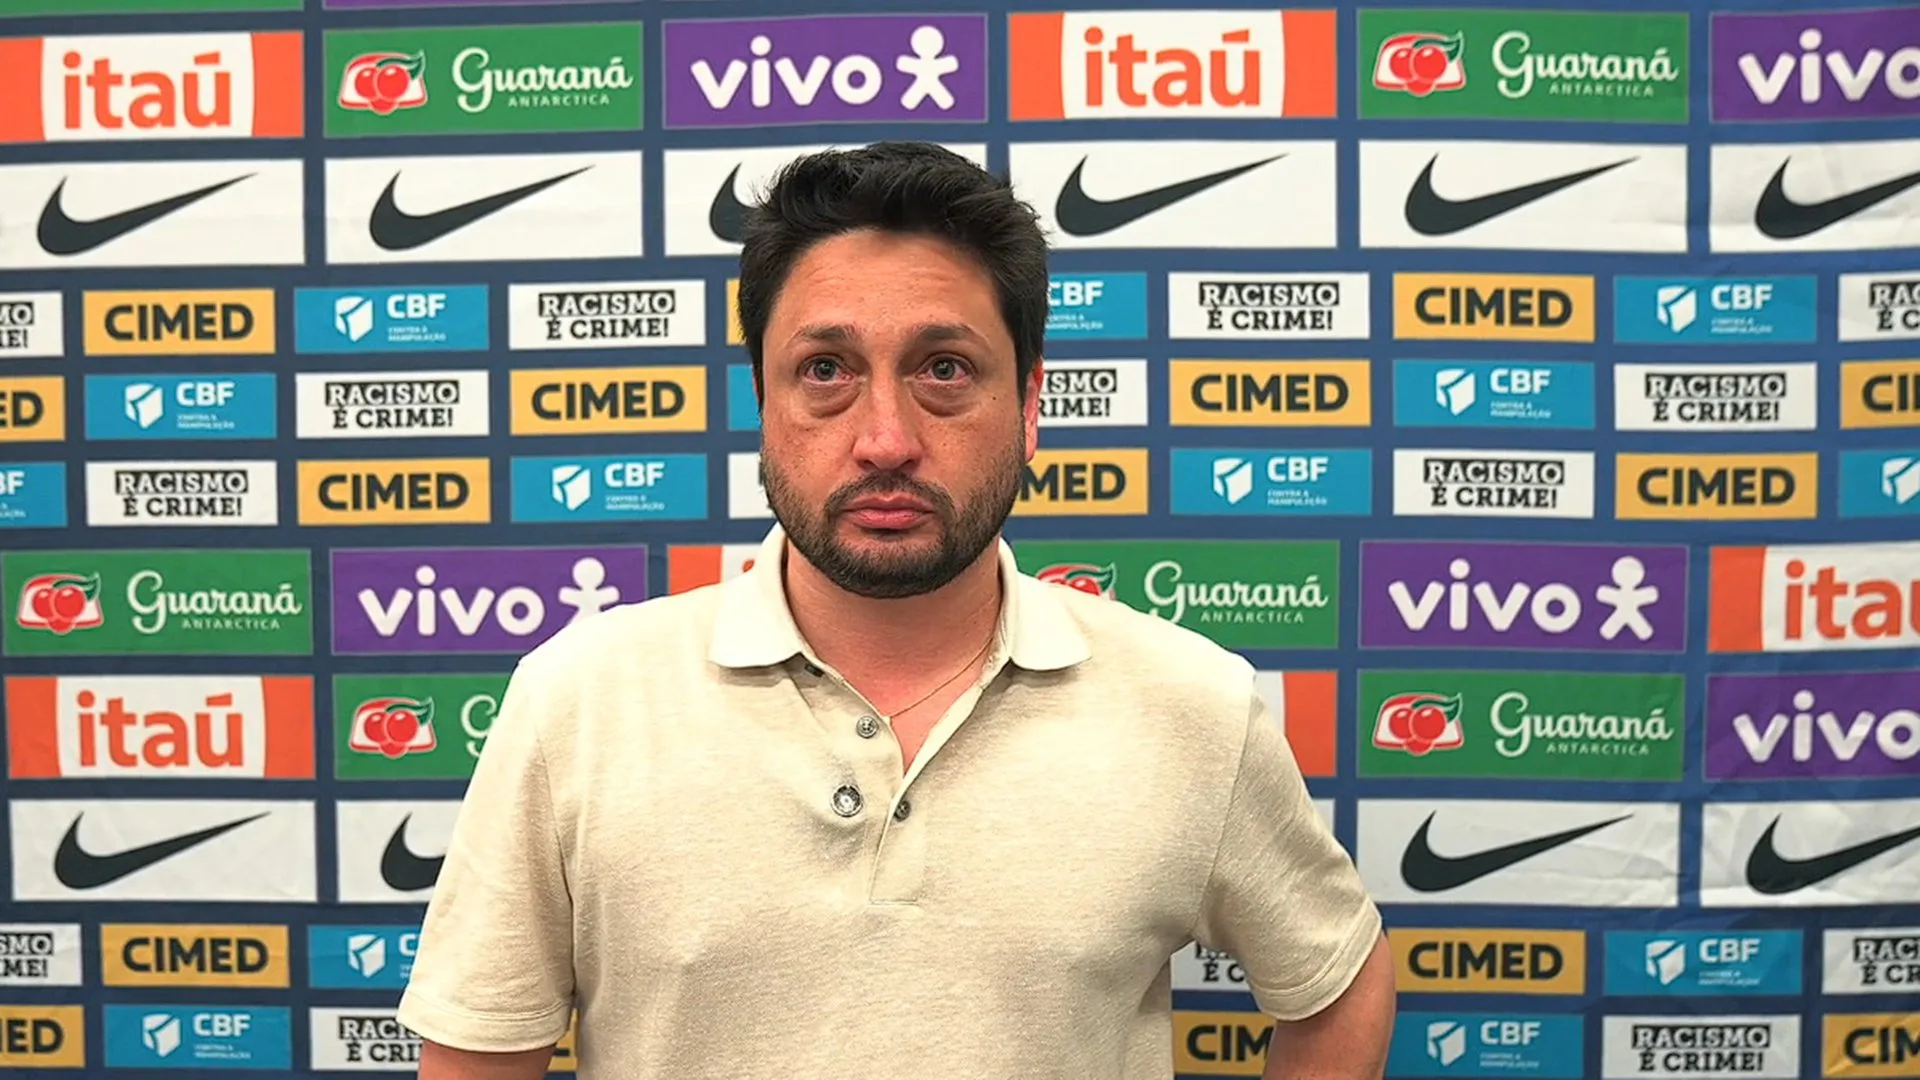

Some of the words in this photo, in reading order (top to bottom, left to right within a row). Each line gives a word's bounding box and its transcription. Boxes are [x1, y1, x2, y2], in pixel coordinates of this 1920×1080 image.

[690, 35, 882, 109] vivo
[1083, 27, 1261, 107] itaú
[1490, 30, 1679, 98] Guaraná
[63, 51, 232, 129] itaú
[451, 47, 632, 112] Guaraná
[1549, 82, 1654, 97] ANTARCTICA
[508, 95, 610, 108] ANTARCTICA
[387, 294, 446, 319] CBF
[541, 291, 673, 315] RACISMO
[1202, 284, 1338, 305] RACISMO
[1415, 287, 1573, 327] CIMED
[1711, 284, 1773, 310] CBF
[104, 303, 254, 341] CIMED
[547, 317, 561, 339] É
[570, 318, 668, 338] CRIME!
[1208, 306, 1222, 329] É
[1231, 310, 1332, 329] CRIME!
[328, 382, 457, 405] RACISMO
[1191, 374, 1349, 412] CIMED
[1490, 369, 1551, 393] CBF
[1648, 375, 1784, 397] RACISMO
[176, 382, 235, 406] CBF
[531, 381, 685, 420] CIMED
[334, 406, 347, 428] É
[355, 408, 453, 427] CRIME!
[1653, 399, 1669, 421] É
[1677, 401, 1779, 421] CRIME!
[605, 463, 664, 487] CBF
[1020, 463, 1126, 502] MED
[1267, 457, 1328, 483] CBF
[1427, 461, 1562, 484] RACISMO
[118, 472, 247, 494] RACISMO
[319, 473, 469, 511] CIMED
[1637, 467, 1796, 506] CIMED
[124, 496, 138, 517] É
[147, 497, 241, 517] CRIME!
[1431, 484, 1447, 508] É
[1456, 488, 1557, 508] CRIME!
[127, 570, 302, 634] Guaraná
[358, 566, 545, 637] vivo
[1145, 561, 1328, 624] Guaraná
[1388, 559, 1581, 632] vivo
[182, 619, 280, 630] ANTARCTICA
[1200, 612, 1303, 624] ANTARCTICA
[76, 691, 242, 767] itaú
[1490, 692, 1674, 757] Guaraná
[1733, 690, 1920, 762] vivo
[1546, 744, 1649, 756] ANTARCTICA
[122, 937, 268, 973] CIMED
[1408, 942, 1563, 980] CIMED
[1699, 938, 1760, 963] CBF
[193, 1014, 250, 1037] CBF
[1481, 1021, 1540, 1045] CBF
[1637, 1026, 1770, 1048] RACISMO
[347, 1039, 360, 1061] É
[1187, 1025, 1272, 1061] CIM
[1844, 1028, 1920, 1066] CIM
[1639, 1048, 1654, 1072] É
[1661, 1052, 1764, 1072] CRIME!
